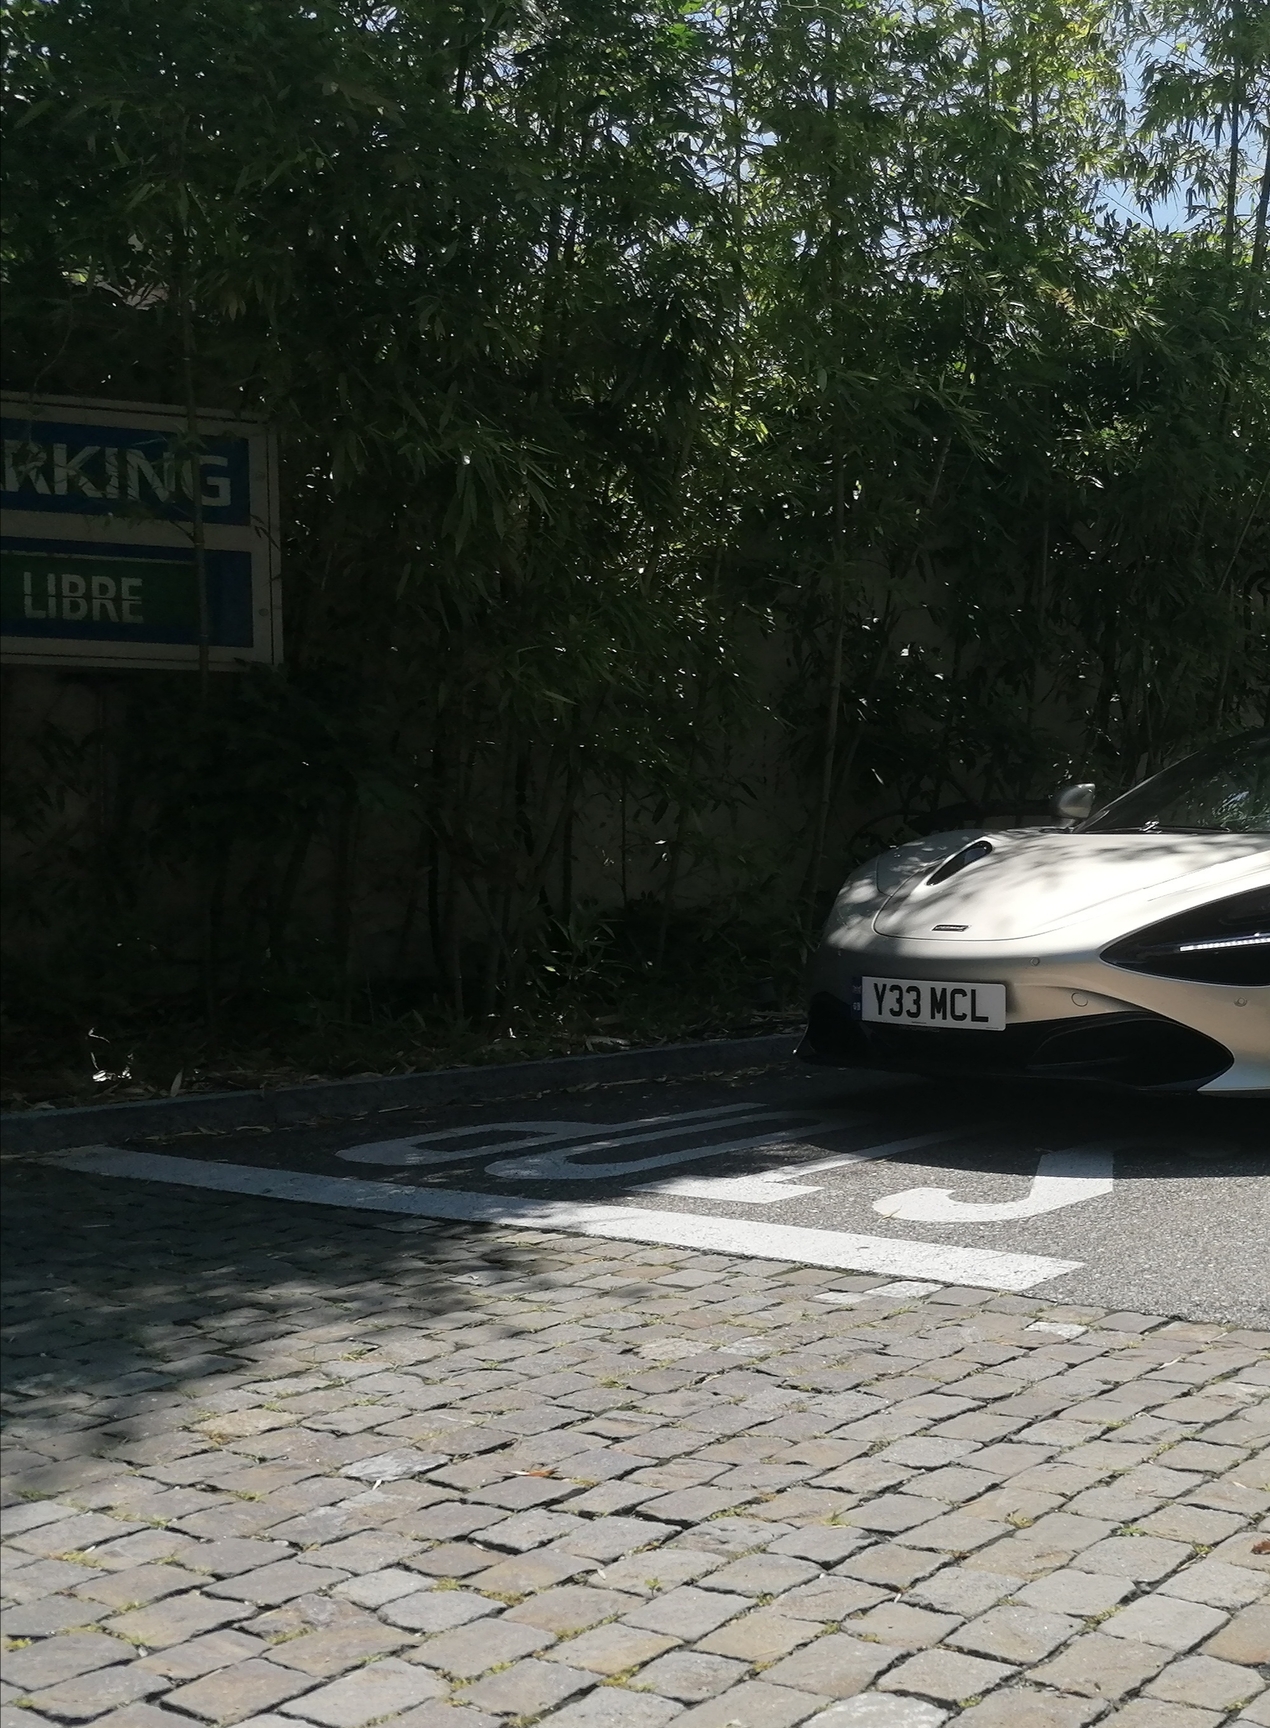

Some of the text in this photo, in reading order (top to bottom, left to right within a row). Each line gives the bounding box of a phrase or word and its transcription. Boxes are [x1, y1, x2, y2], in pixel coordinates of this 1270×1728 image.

[0, 439, 231, 507] RKING
[23, 571, 144, 624] LIBRE
[873, 983, 989, 1023] Y33 MCL
